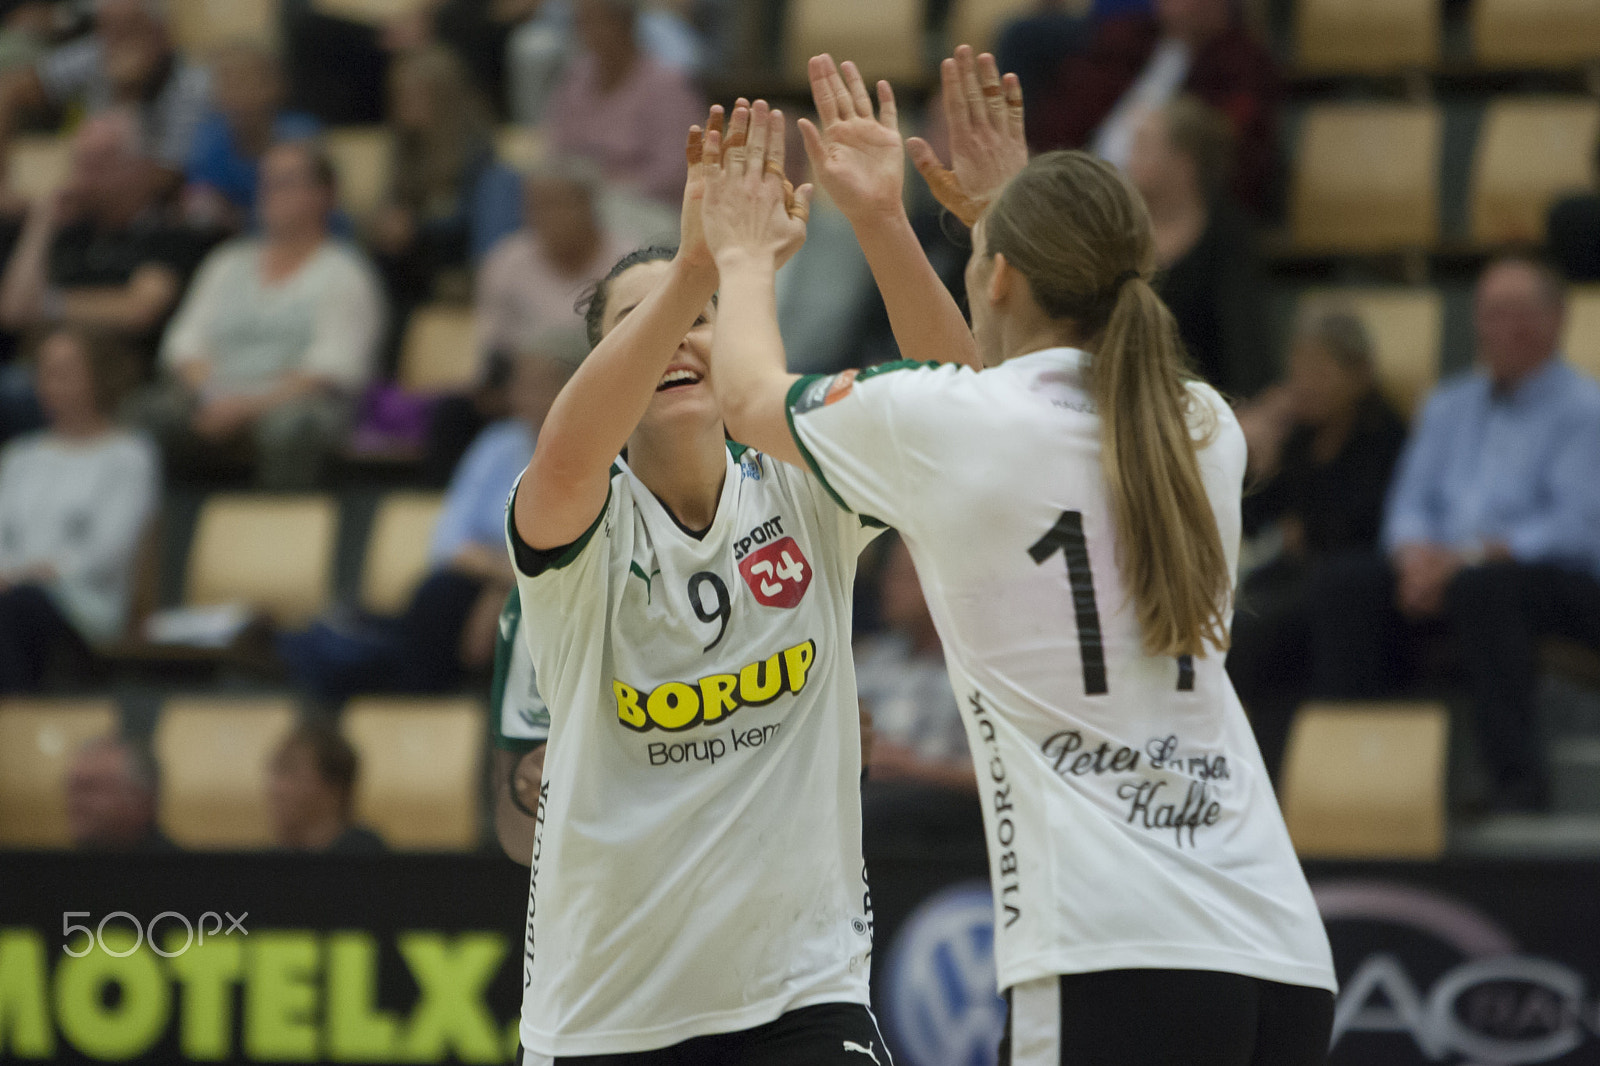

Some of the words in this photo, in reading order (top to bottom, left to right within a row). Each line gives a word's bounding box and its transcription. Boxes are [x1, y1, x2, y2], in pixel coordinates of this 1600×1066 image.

[733, 515, 784, 560] SPORT
[750, 550, 804, 597] 24
[687, 571, 732, 655] 9
[612, 638, 816, 733] BORUP
[648, 738, 725, 766] Borup
[1041, 730, 1140, 776] Peter
[1117, 780, 1220, 849] Kaffe
